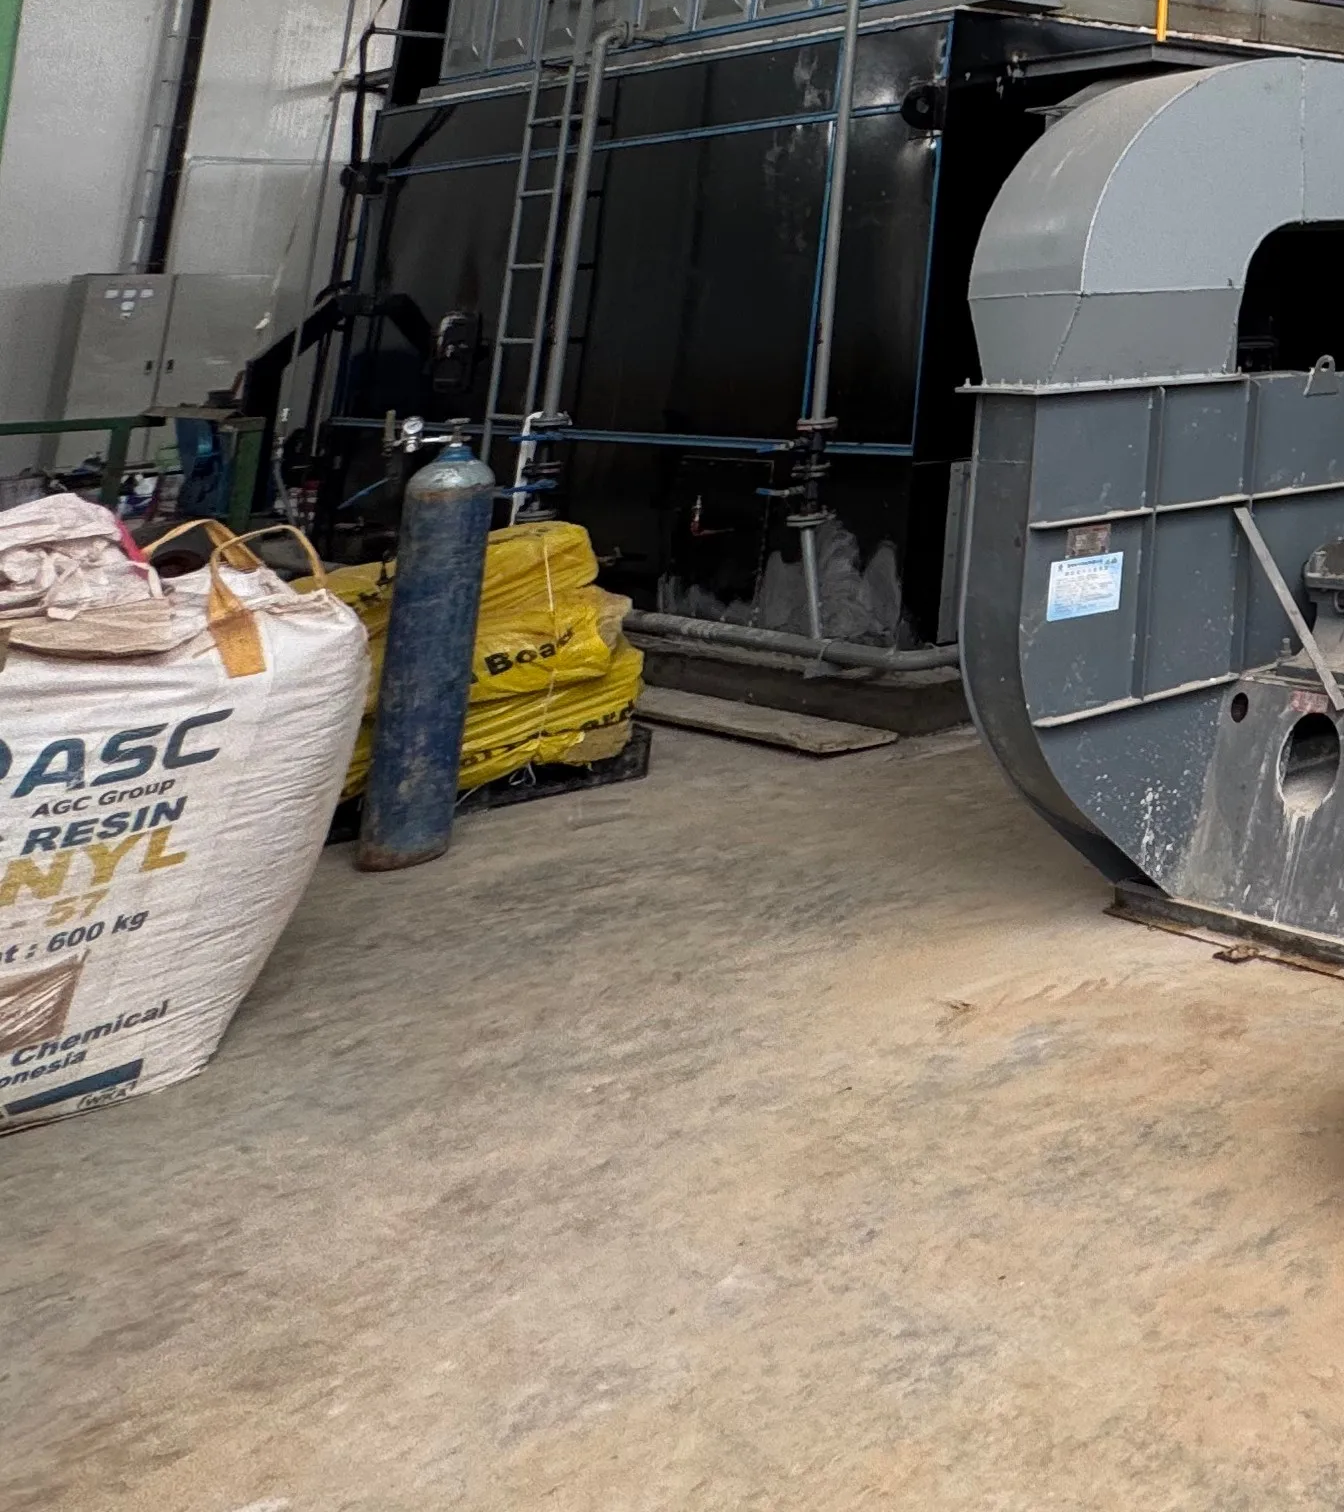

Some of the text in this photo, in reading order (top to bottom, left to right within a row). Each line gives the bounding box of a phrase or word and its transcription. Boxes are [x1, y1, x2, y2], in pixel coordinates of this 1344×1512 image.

[30, 778, 177, 819] AGC Group
[20, 795, 189, 857] RESIN
[46, 920, 106, 953] 600
[111, 909, 150, 934] kg
[10, 998, 170, 1068] Chemical
